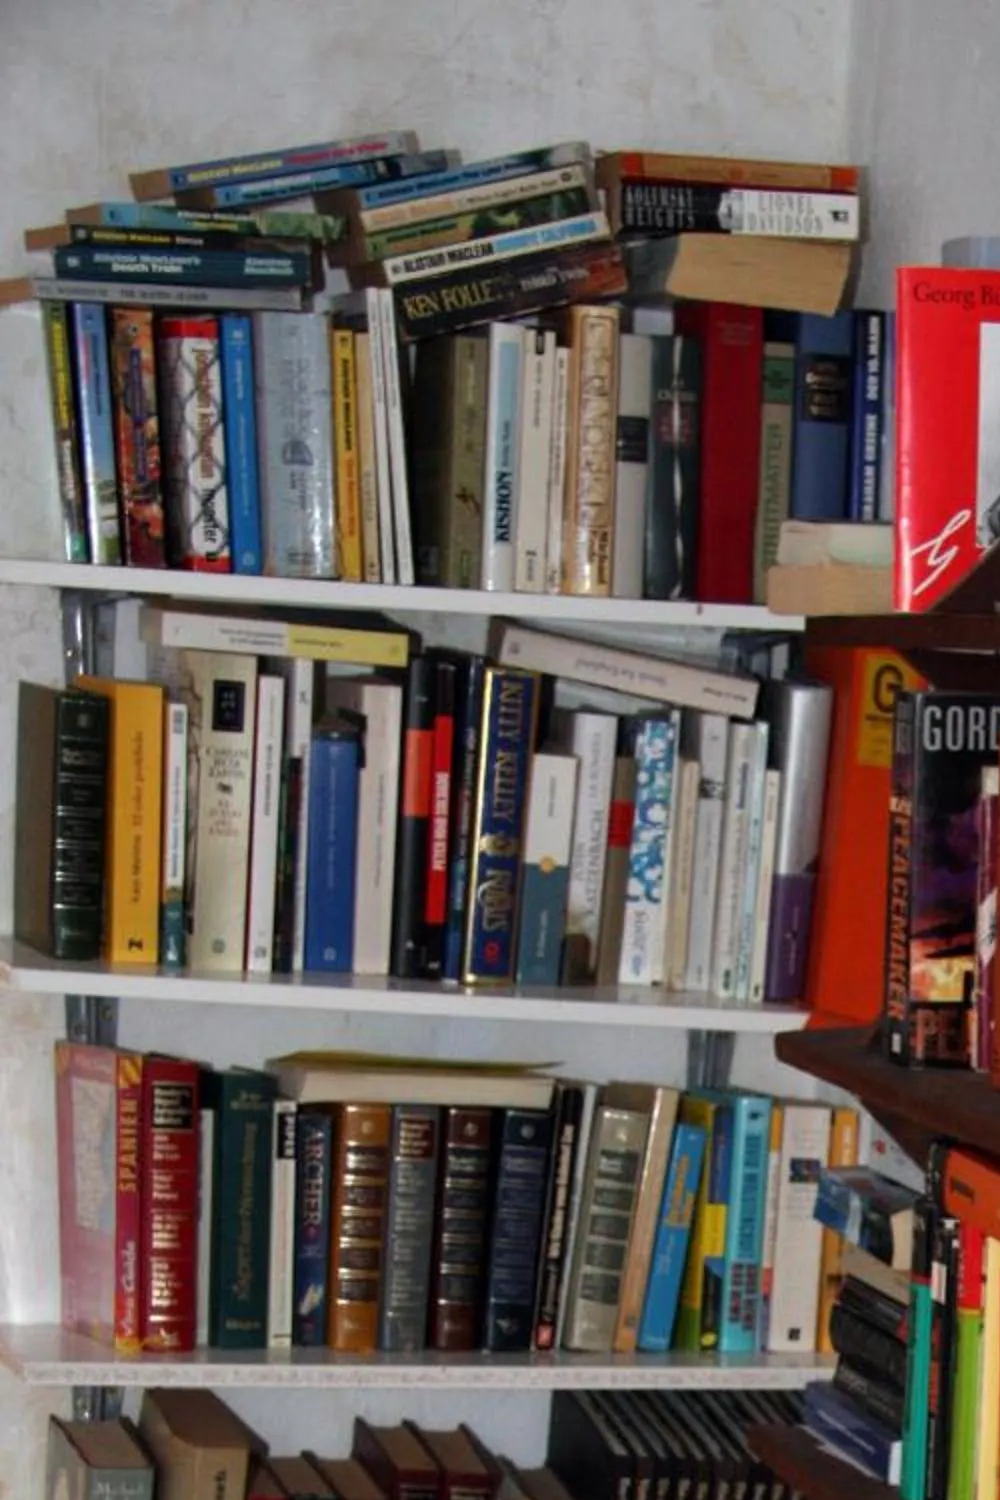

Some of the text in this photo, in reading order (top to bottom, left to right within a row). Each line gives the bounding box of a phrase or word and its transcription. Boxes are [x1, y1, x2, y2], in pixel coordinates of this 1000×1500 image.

[912, 281, 975, 312] Georg
[494, 470, 513, 545] KISHON
[118, 1097, 138, 1193] SPANIEN
[301, 1125, 325, 1226] ARCHER
